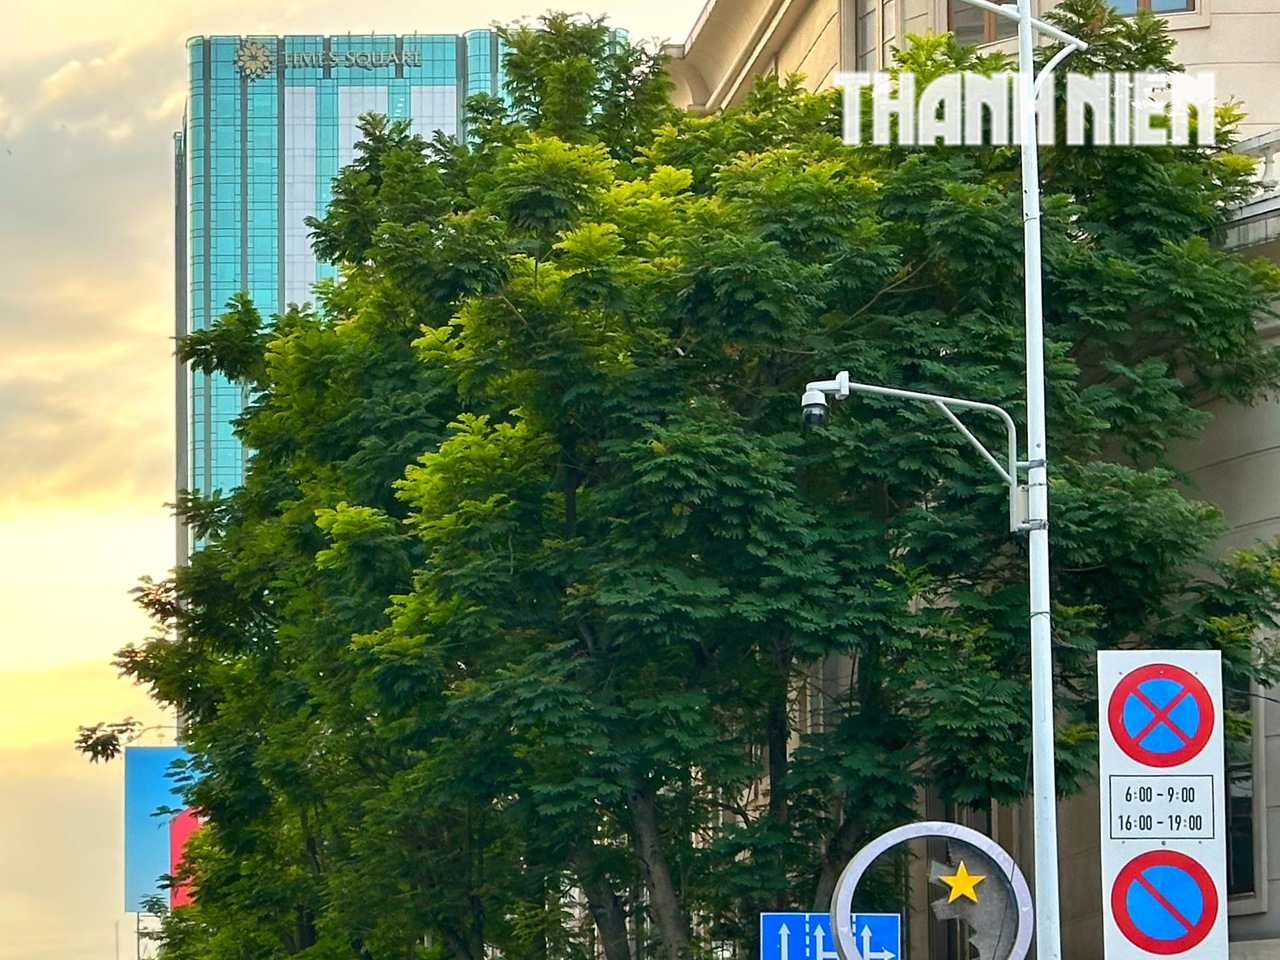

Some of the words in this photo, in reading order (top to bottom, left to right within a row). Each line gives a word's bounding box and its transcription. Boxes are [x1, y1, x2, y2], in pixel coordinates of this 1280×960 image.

[282, 51, 338, 68] TIMES
[344, 51, 422, 71] SQUARE
[1125, 786, 1152, 802] 6:00
[1167, 786, 1195, 803] 9:00
[1118, 815, 1152, 831] 16:00
[1168, 815, 1202, 831] 19:00
